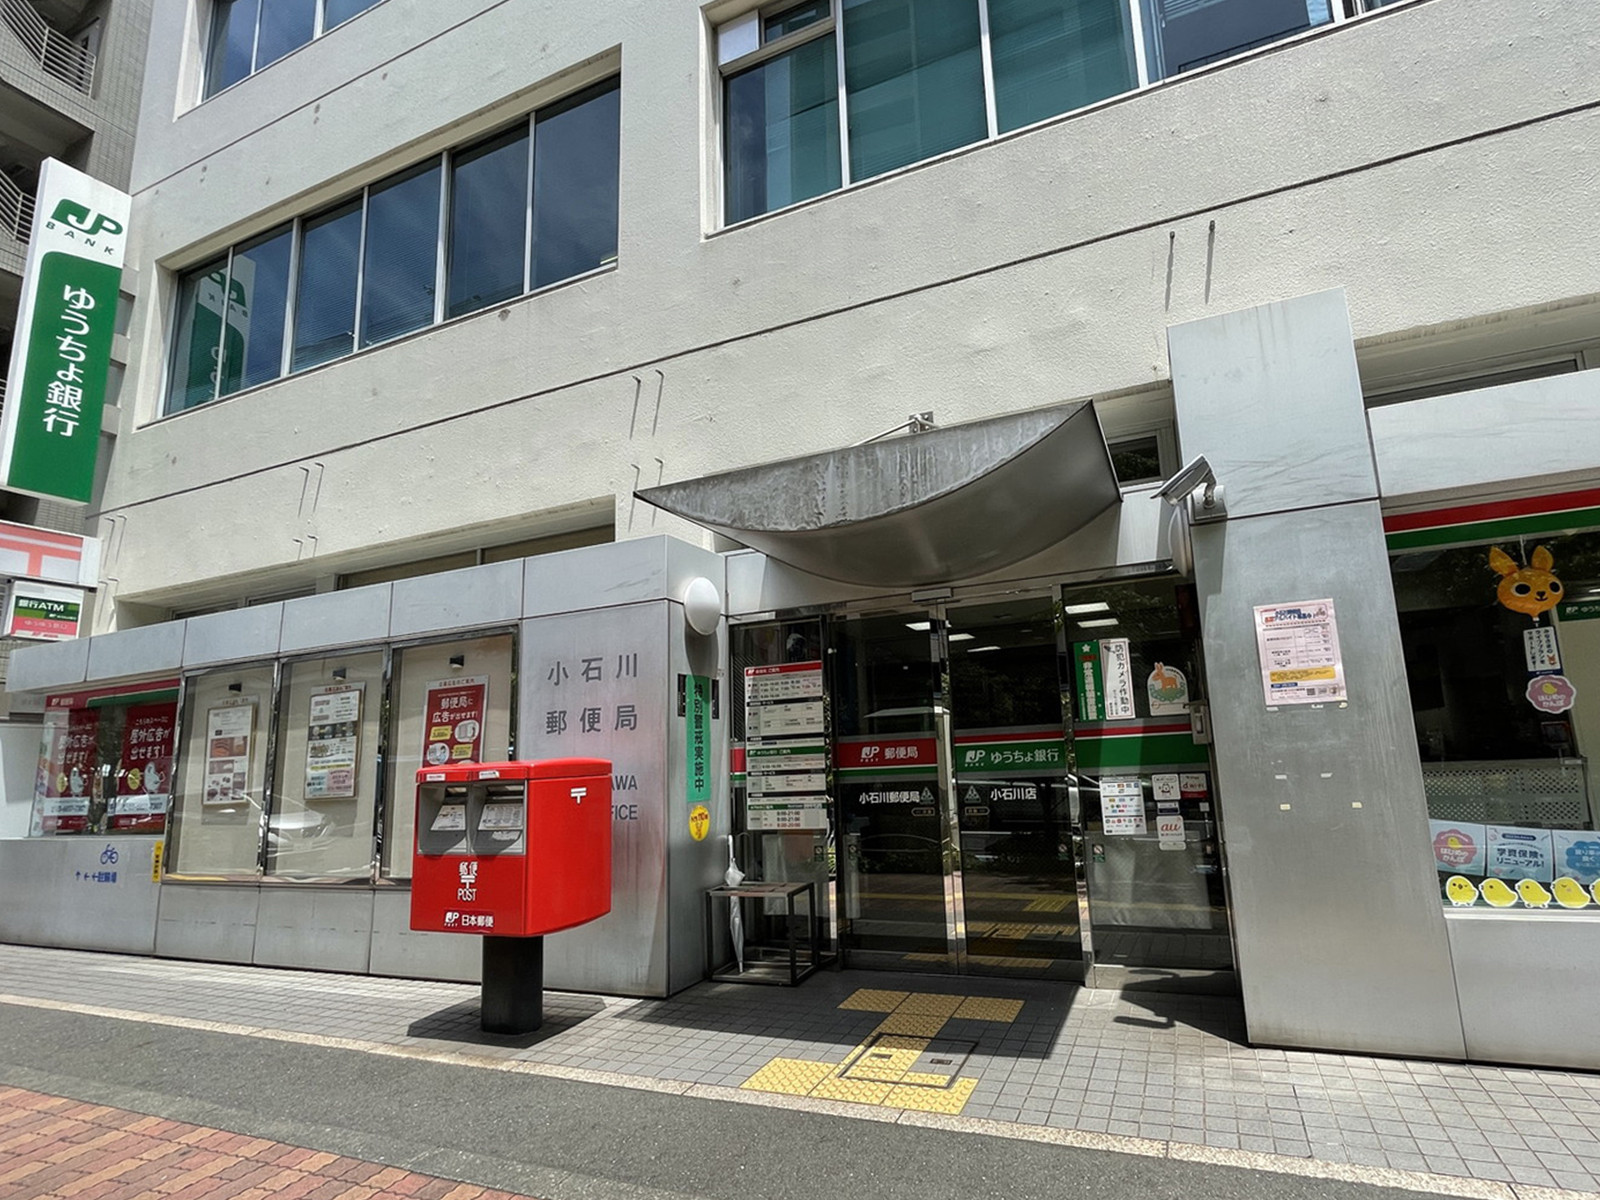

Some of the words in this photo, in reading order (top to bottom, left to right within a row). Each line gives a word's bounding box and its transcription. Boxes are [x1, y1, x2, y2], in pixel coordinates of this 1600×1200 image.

[46, 221, 115, 256] BANK
[42, 284, 96, 437] ゆうちょ銀行
[547, 653, 638, 686] 小石川
[1115, 644, 1130, 714] 防犯カメラ作動中
[441, 696, 474, 710] 郵便局に
[546, 705, 638, 735] 郵便局
[884, 746, 918, 759] 郵便局
[990, 748, 1060, 764] ゆうちょ銀行
[859, 790, 920, 805] 小石川郵便局
[990, 787, 1037, 801] 小石川店
[1161, 823, 1181, 832] au
[459, 861, 478, 876] 郵便
[1496, 857, 1545, 868] リニューアル!
[457, 888, 477, 901] POST
[461, 915, 494, 927] 日本郵便
